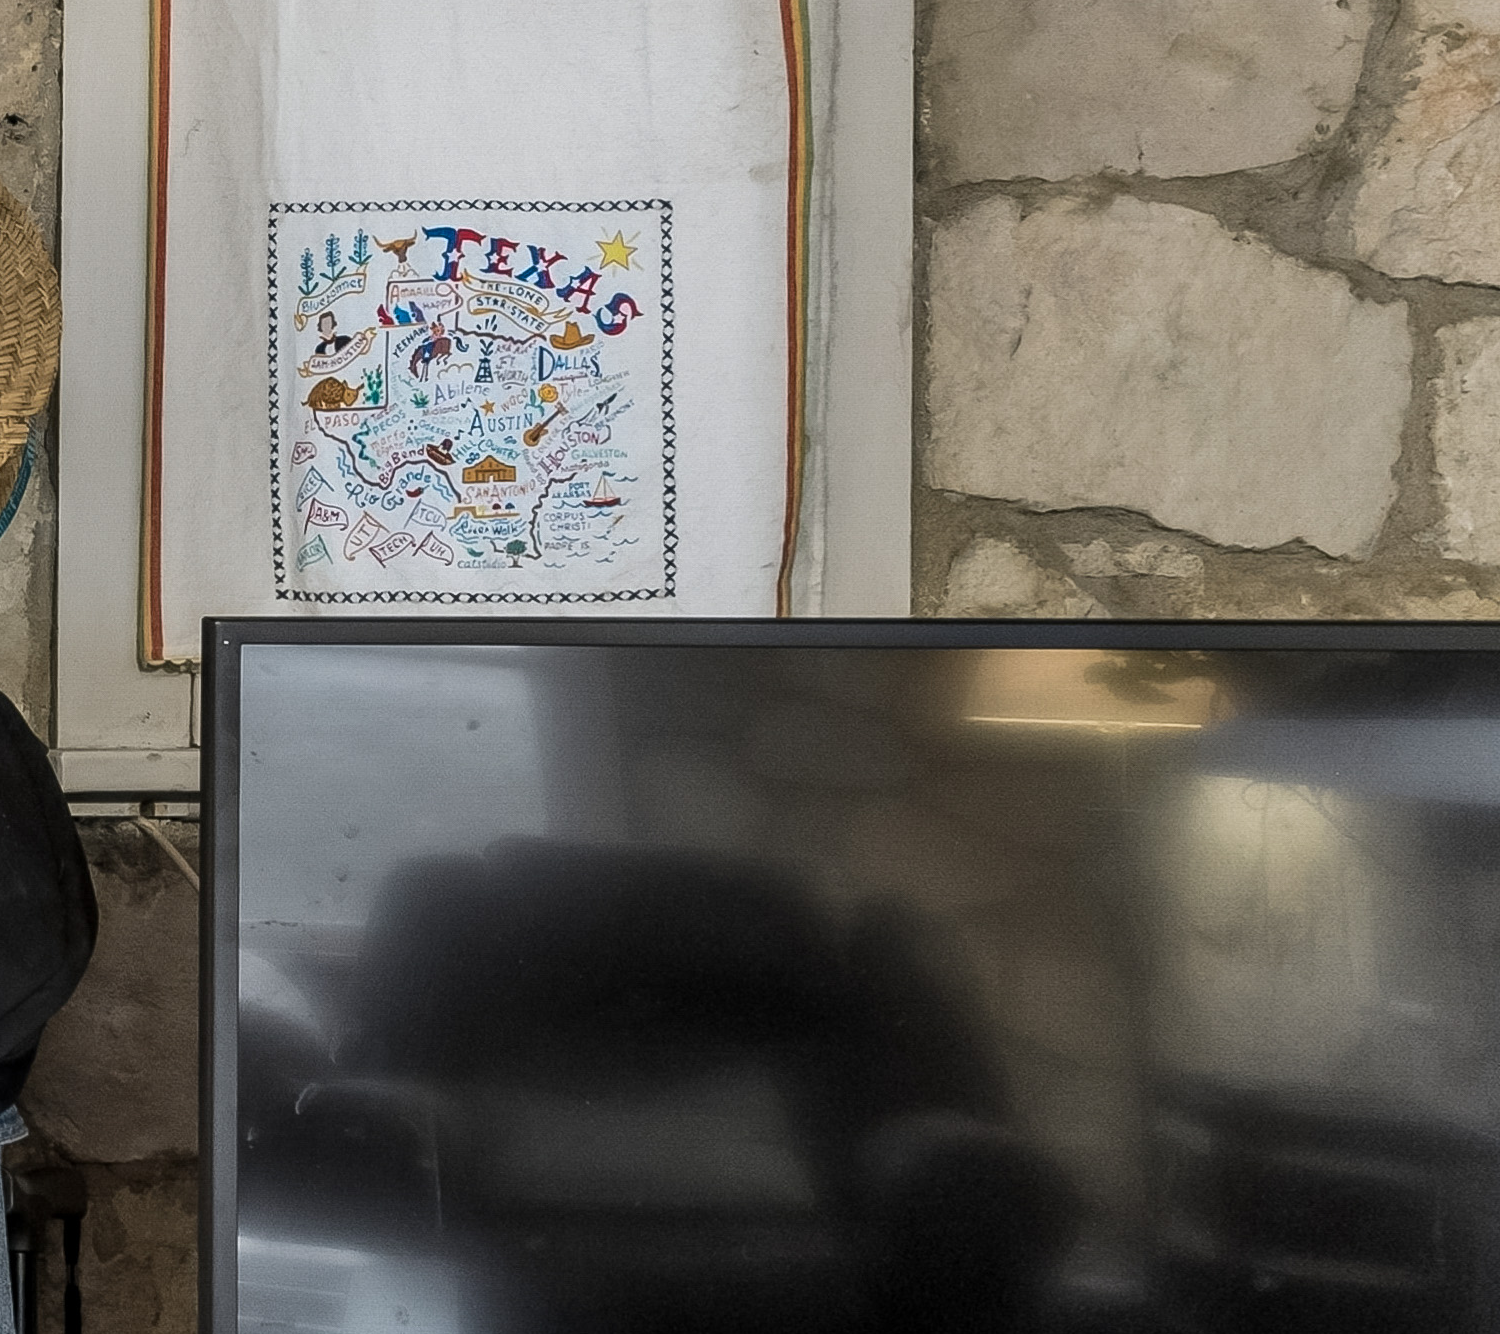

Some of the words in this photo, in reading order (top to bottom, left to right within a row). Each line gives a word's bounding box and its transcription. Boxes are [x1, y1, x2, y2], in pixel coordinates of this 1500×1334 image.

[422, 226, 644, 336] TEXAS
[390, 283, 453, 304] AMARILLO
[423, 299, 452, 309] HAPPY
[510, 306, 545, 331] STATE
[539, 346, 602, 381] DALLAS
[434, 380, 490, 406] Abilene
[304, 419, 317, 434] EL
[324, 413, 360, 429] PASO
[372, 409, 406, 436] PECOS
[468, 408, 533, 436] AUSTIN
[452, 439, 477, 461] HILL
[537, 430, 601, 476] HOUSTON
[571, 449, 628, 461] GALVESTON
[378, 459, 393, 485] Big
[391, 444, 425, 466] Bend
[345, 482, 380, 508] Rio
[381, 466, 432, 511] Grande
[315, 507, 340, 522] A&M
[419, 511, 442, 525] TCU
[543, 512, 586, 523] CORPUS
[349, 524, 372, 547] UT
[379, 536, 409, 556] TECH
[430, 542, 447, 556] UH
